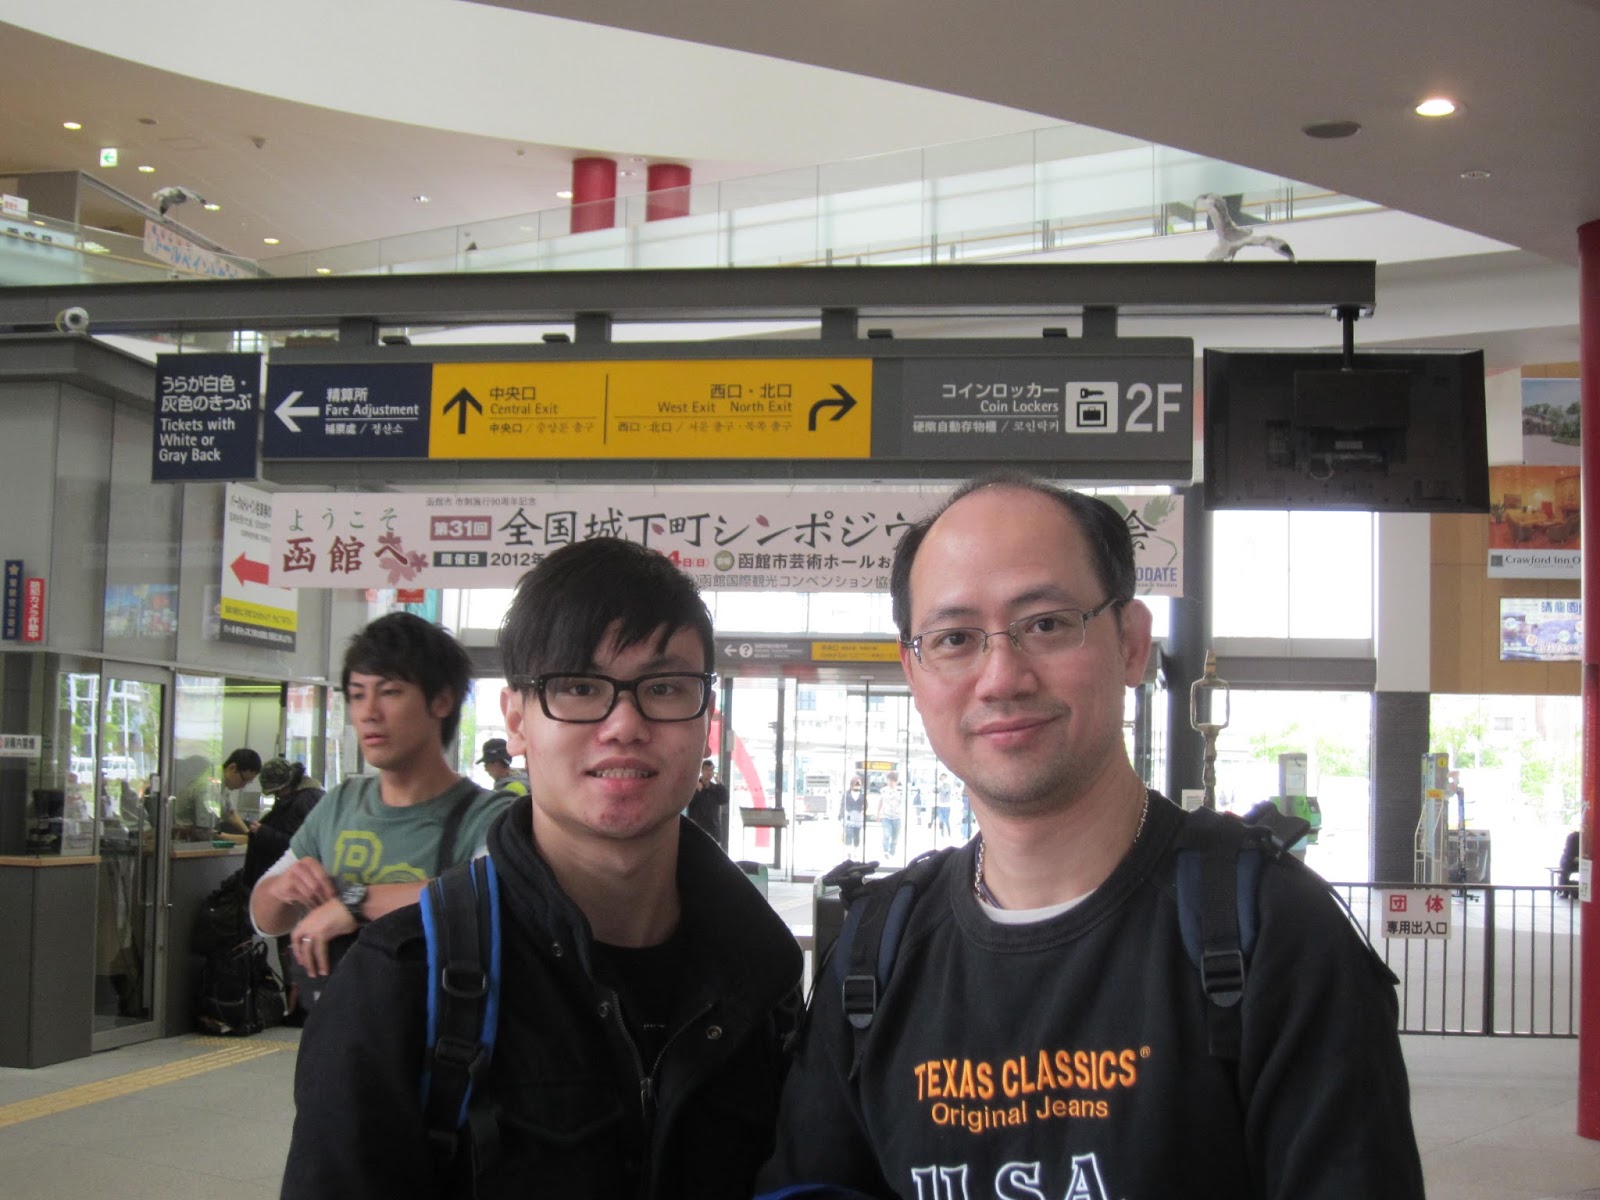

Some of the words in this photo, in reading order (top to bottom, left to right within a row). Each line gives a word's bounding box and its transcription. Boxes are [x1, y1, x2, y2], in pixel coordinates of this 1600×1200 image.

[326, 387, 368, 402] 精算所
[490, 386, 536, 401] 中央口
[711, 384, 792, 399] 西口・北口
[942, 382, 1059, 399] コインロッカー
[161, 394, 252, 412] 灰色のきっぷ
[325, 404, 350, 416] Fare
[352, 403, 419, 418] Adjustment
[490, 403, 530, 415] Central
[534, 403, 558, 414] Exit
[658, 401, 688, 413] West
[692, 401, 716, 413] Exit
[730, 401, 764, 412] North
[768, 400, 792, 412] Exit
[980, 400, 1008, 413] Coin
[1012, 400, 1059, 412] Lockers
[1125, 383, 1182, 432] 2F
[161, 418, 203, 431] Tickets
[207, 418, 235, 430] with
[371, 423, 403, 436] 정산소
[489, 422, 522, 433] 中央口
[160, 433, 196, 447] White
[201, 436, 214, 446] or
[159, 448, 187, 464] Gray
[191, 448, 221, 461] Back
[288, 507, 399, 532] ようこそ
[434, 520, 489, 537] 第31回
[283, 536, 408, 574] 函館へ
[440, 553, 480, 566] 開催日
[1505, 554, 1551, 566] Crawford
[1554, 555, 1570, 565] Inn
[1572, 556, 1581, 565] O
[1135, 566, 1178, 582] ODATE
[1389, 894, 1444, 913] 団体
[1386, 920, 1448, 935] 専用出入口
[914, 1059, 995, 1101] TEXAS
[931, 1100, 1028, 1134] Original
[1036, 1096, 1109, 1120] Jeans
